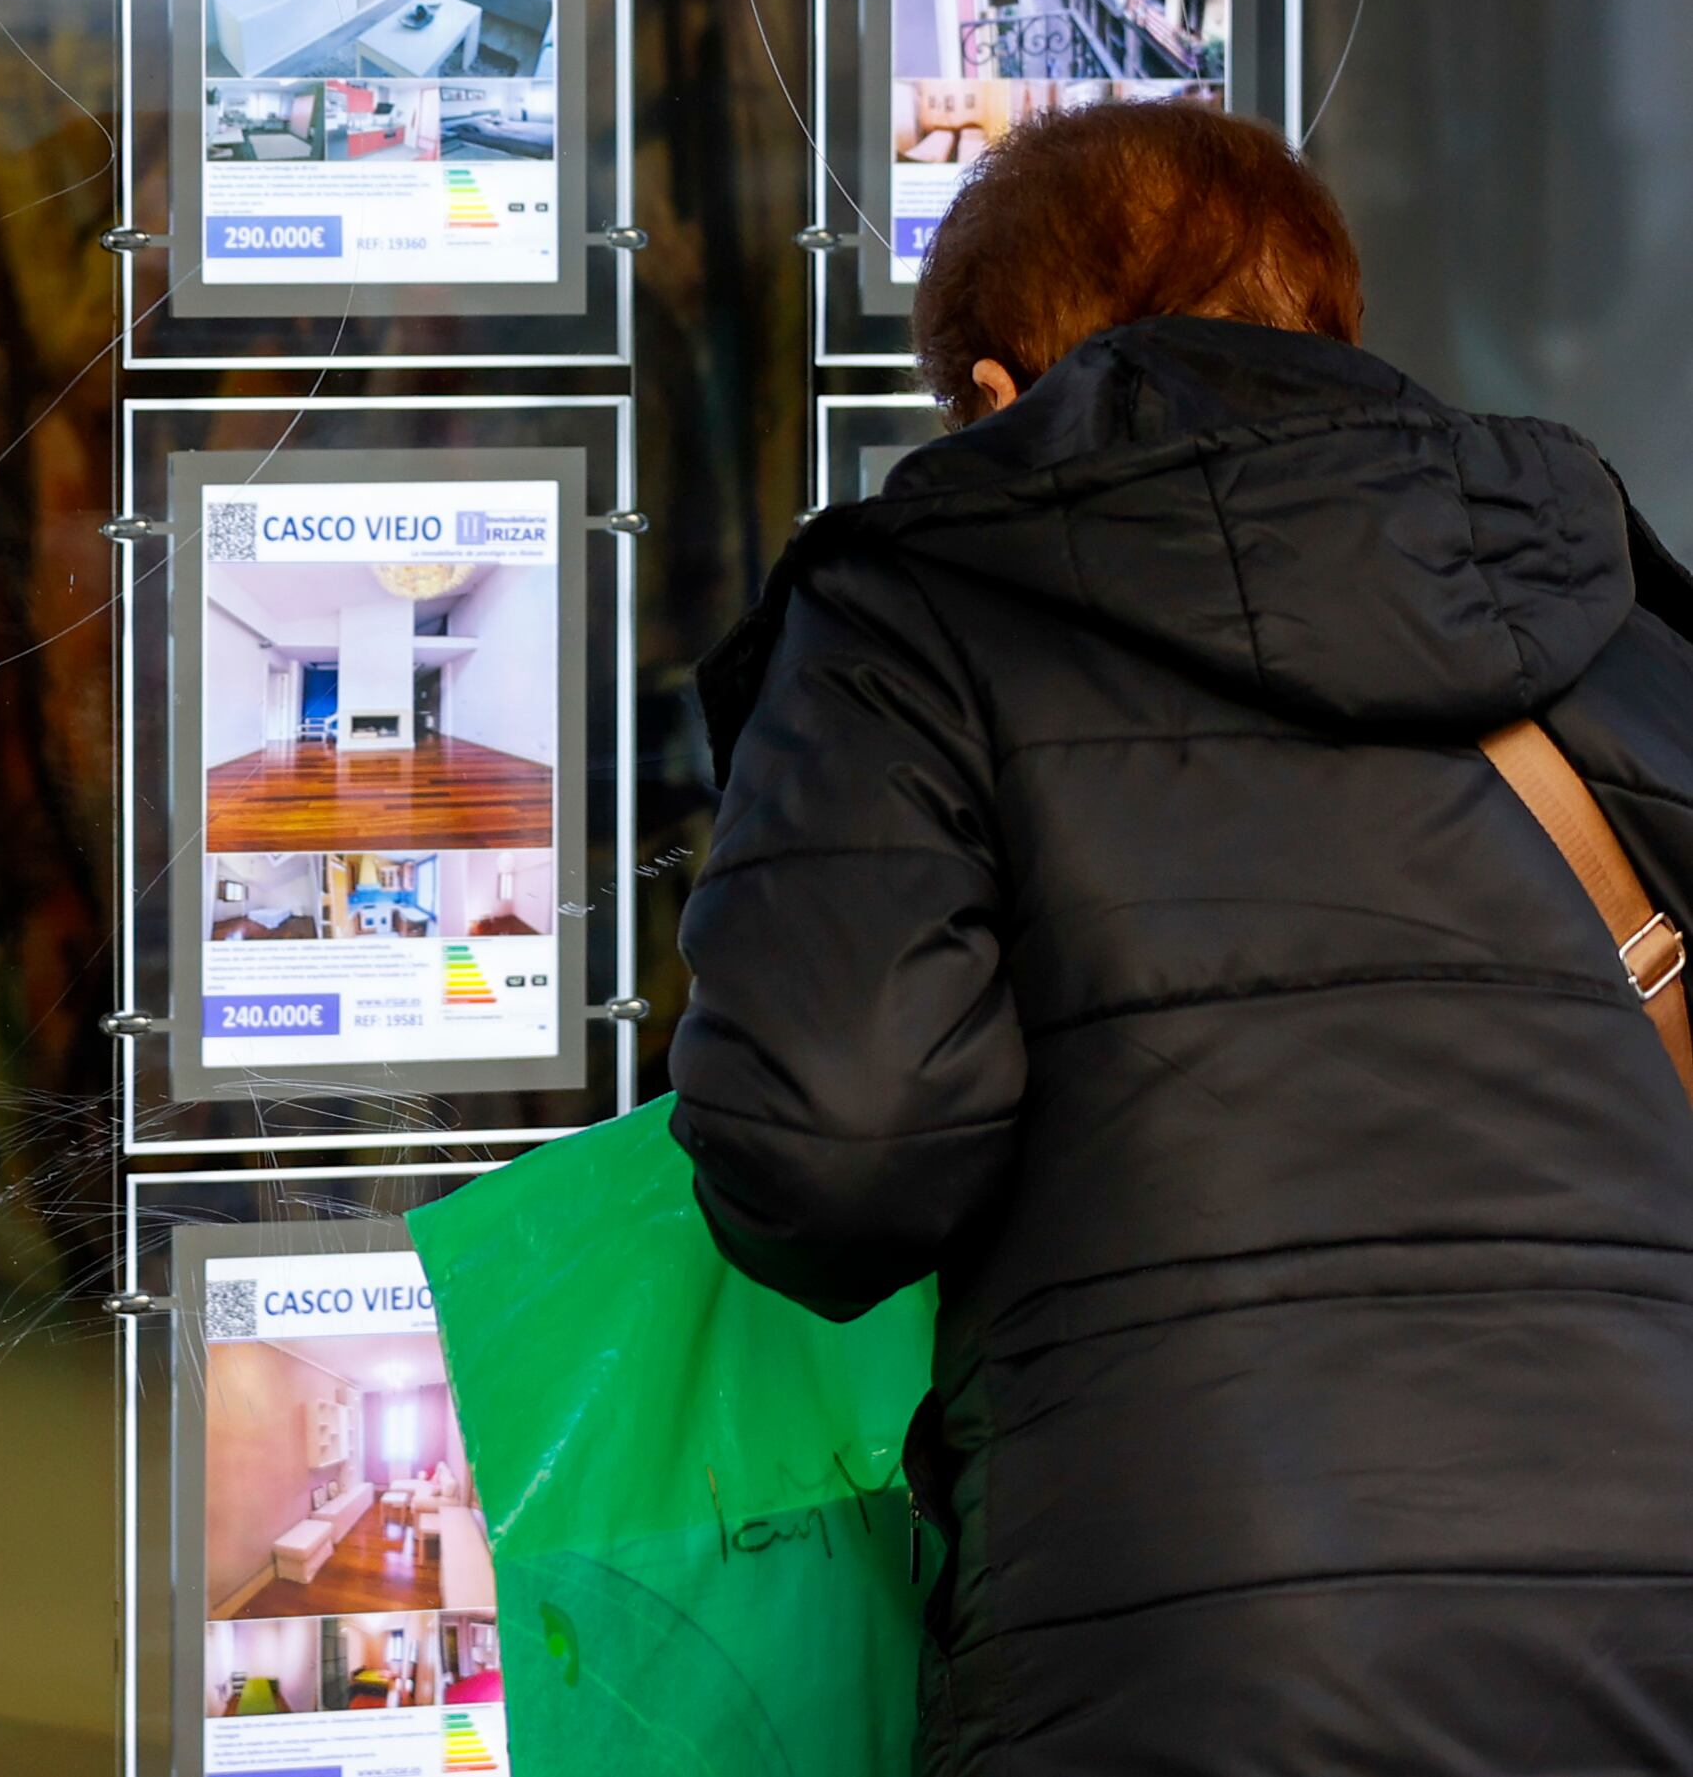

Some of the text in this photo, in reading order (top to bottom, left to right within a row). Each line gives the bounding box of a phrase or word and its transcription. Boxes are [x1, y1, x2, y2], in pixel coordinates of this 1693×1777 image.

[225, 226, 324, 248] 290.000€
[357, 238, 427, 250] REF: 19360
[263, 516, 442, 541] CASCO VIEJO
[485, 527, 545, 541] IRIZAR
[222, 1005, 323, 1028] 240.000€
[264, 1285, 433, 1316] CASCO VIEJO
